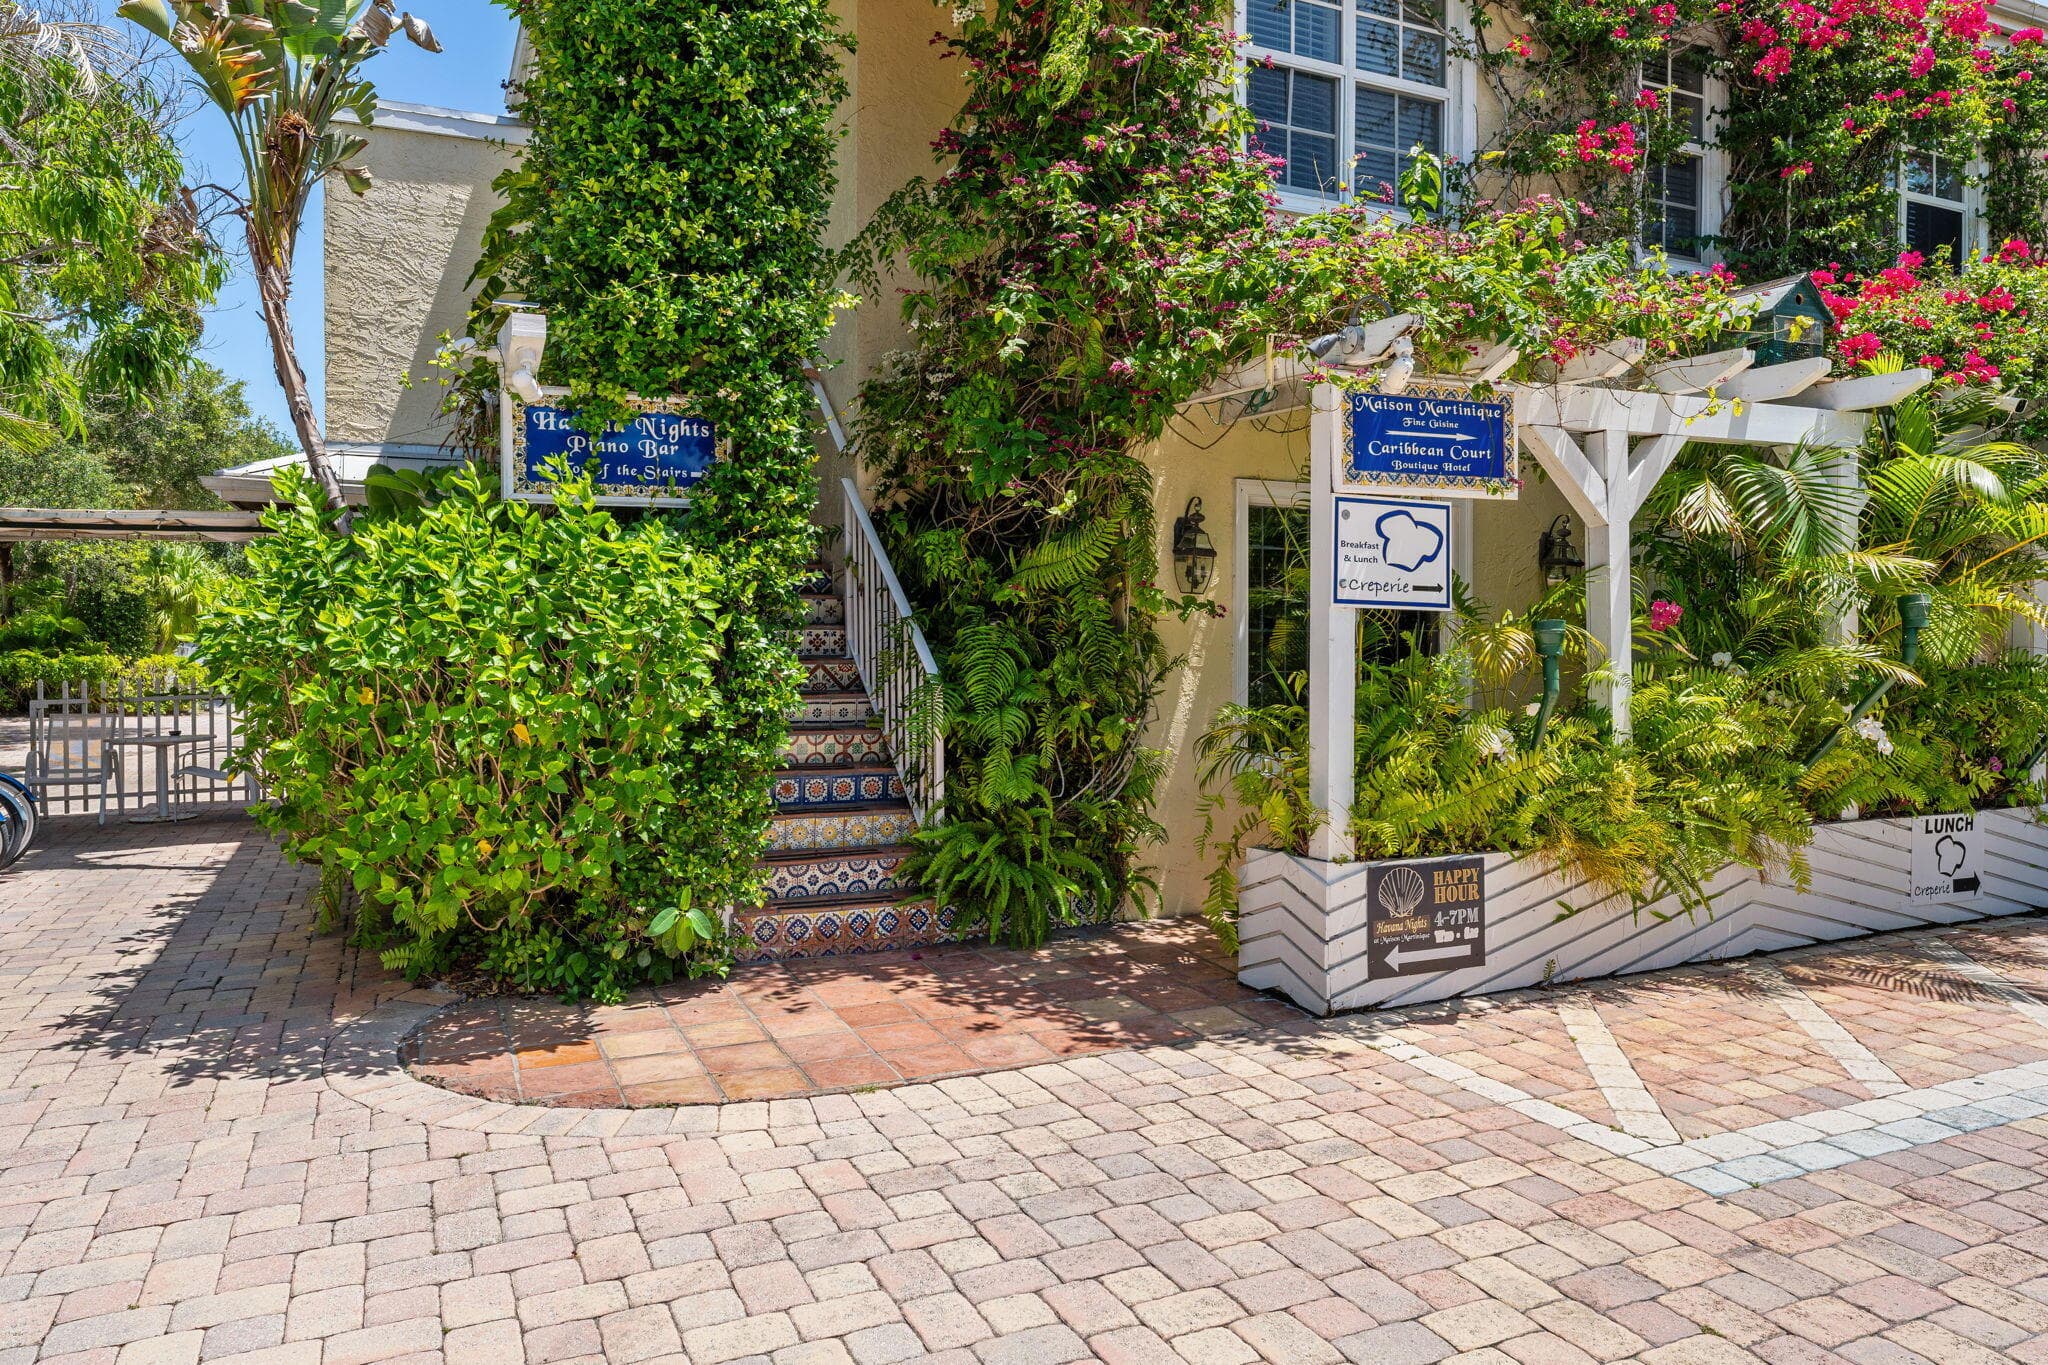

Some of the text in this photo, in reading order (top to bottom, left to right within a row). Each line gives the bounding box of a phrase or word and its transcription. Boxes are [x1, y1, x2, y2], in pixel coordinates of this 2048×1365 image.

[1355, 396, 1501, 421] Maison Martinique
[533, 411, 710, 443] Hana Nights
[1402, 417, 1459, 429] Fine Cuisine
[567, 435, 679, 459] Piano Bar
[1368, 440, 1492, 461] Caribbean Court
[617, 464, 637, 476] the
[1391, 460, 1471, 472] Boutique Hotel
[1340, 540, 1379, 550] Breakfast
[1353, 555, 1378, 564] Lunch
[1348, 577, 1410, 597] Creperie
[1925, 816, 1974, 834] LUNCH
[1433, 868, 1480, 886] HAPPY
[1434, 884, 1480, 904] HOUR
[1915, 880, 1951, 900] Creperie
[1376, 916, 1428, 934] Havana Nights
[1434, 907, 1480, 927] 4-7PM
